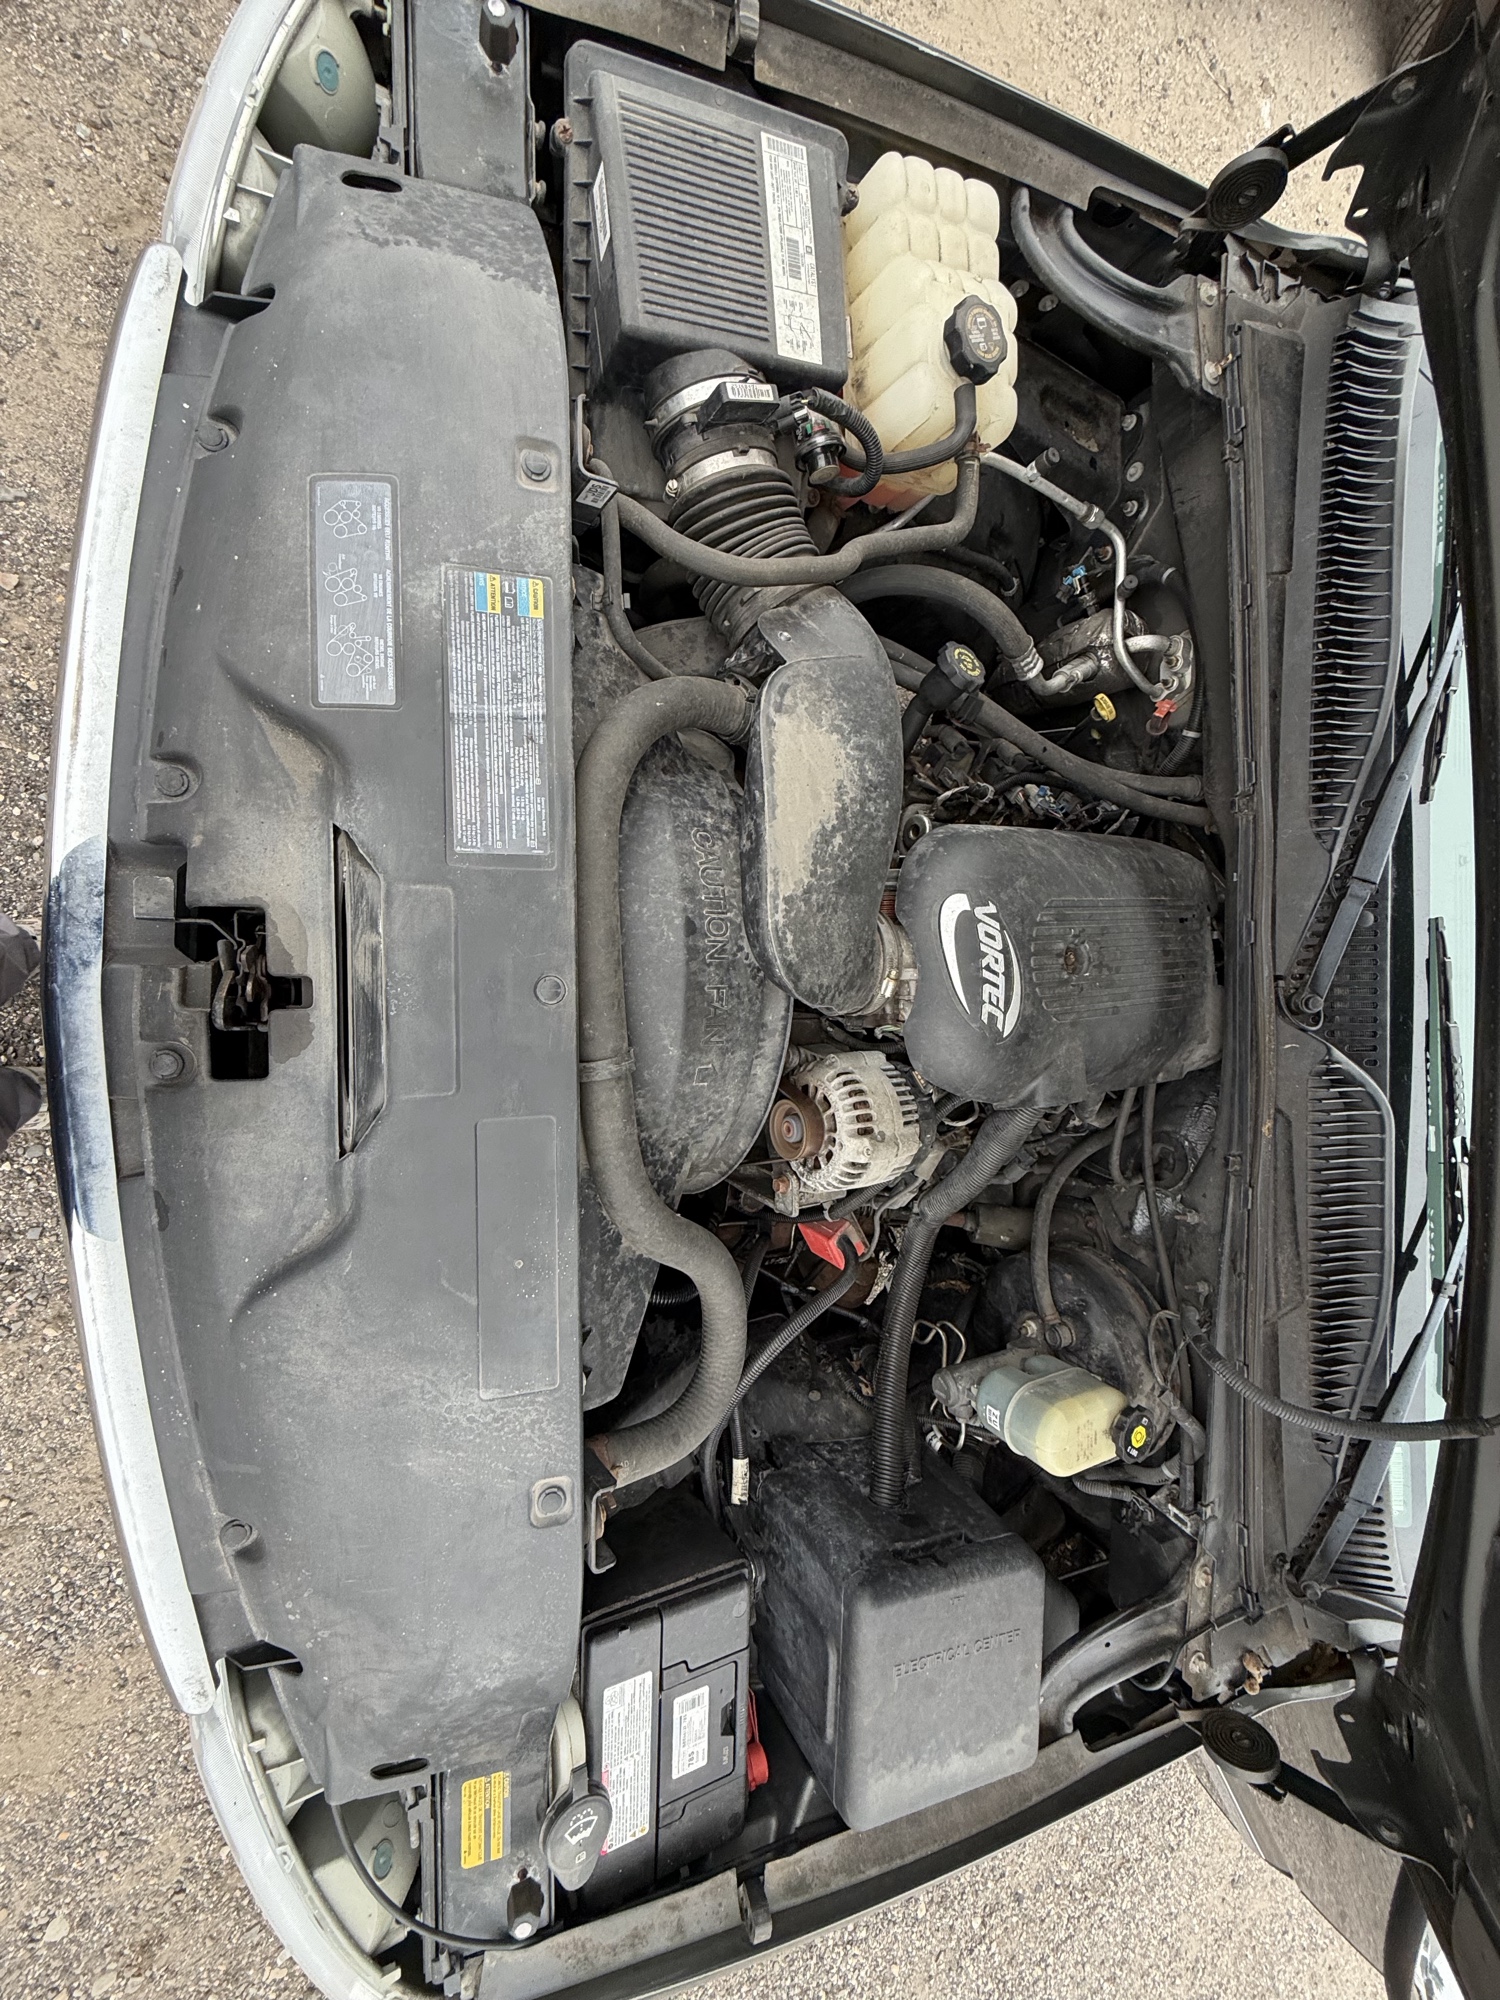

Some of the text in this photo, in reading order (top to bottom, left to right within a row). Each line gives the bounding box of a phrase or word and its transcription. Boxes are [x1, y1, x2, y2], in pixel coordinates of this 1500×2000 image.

[692, 828, 730, 1047] CAUTION FAN
[973, 901, 1005, 1032] VORTEC
[893, 1628, 1021, 1679] ELECTRICAL CENTER
